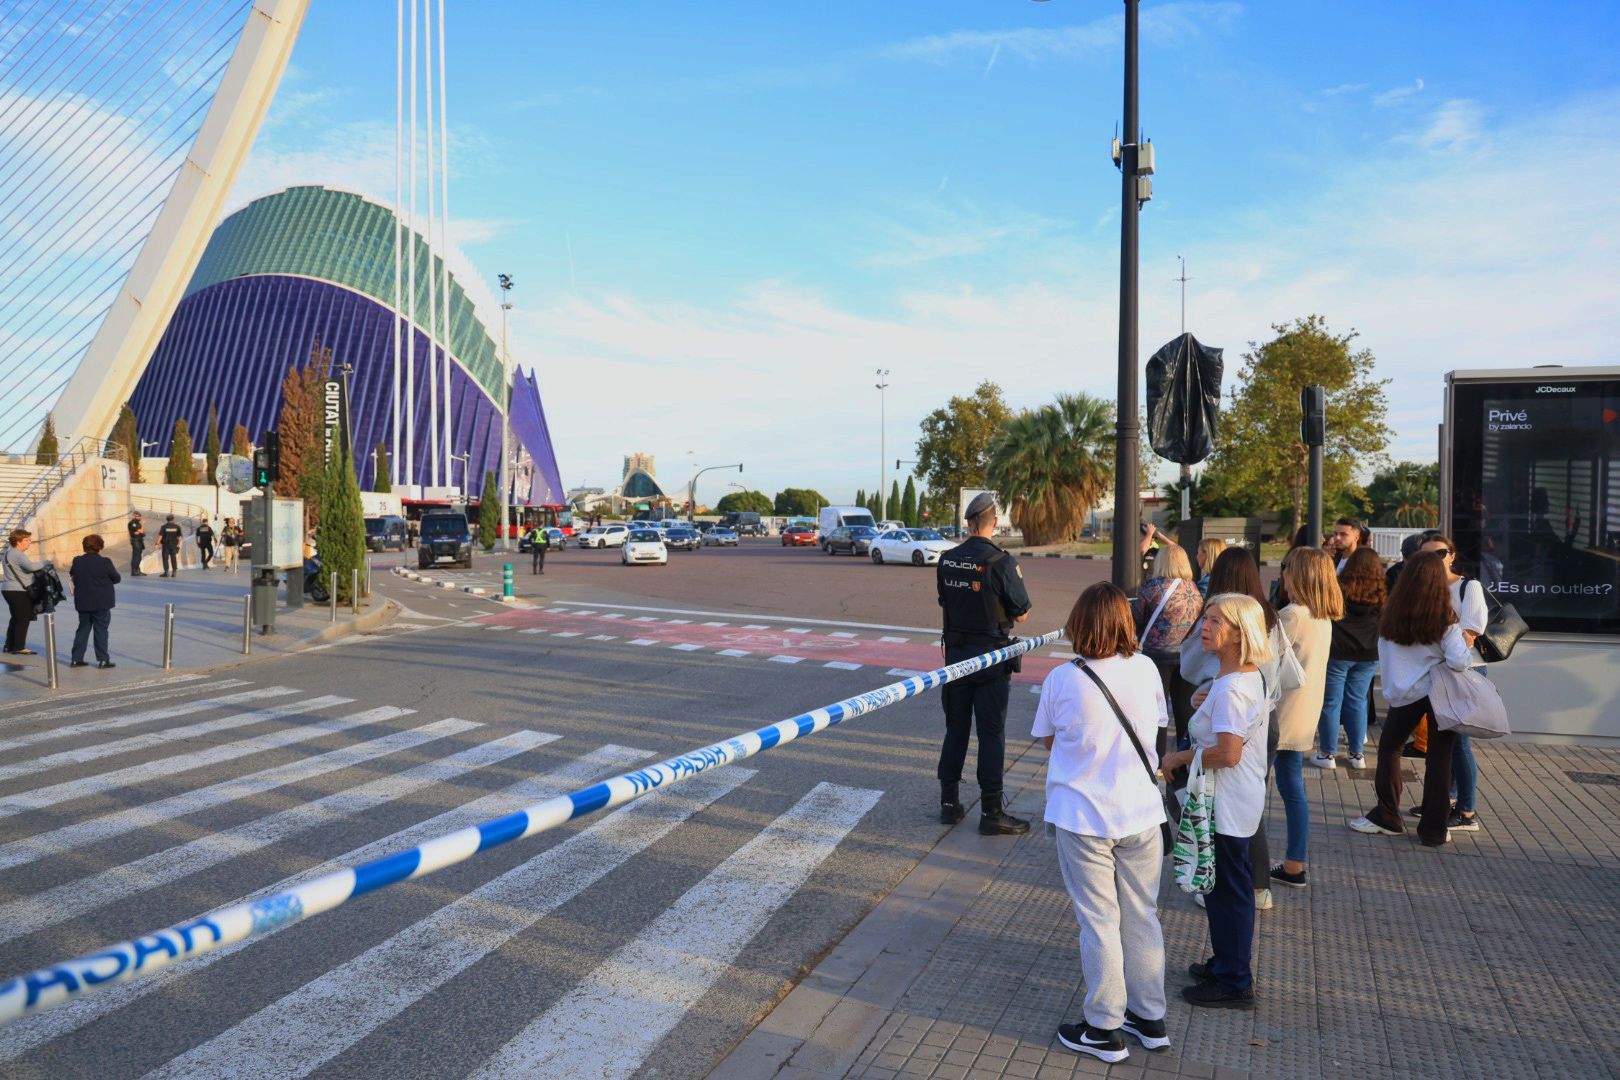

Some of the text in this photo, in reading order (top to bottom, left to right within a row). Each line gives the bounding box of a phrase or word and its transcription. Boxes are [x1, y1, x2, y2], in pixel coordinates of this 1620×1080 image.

[325, 382, 340, 427] CIUTAT
[1488, 409, 1528, 422] Privé
[1488, 423, 1500, 431] by
[101, 465, 108, 488] P
[943, 559, 977, 570] POLICIA
[1486, 581, 1613, 595] ¿Es un outlet?
